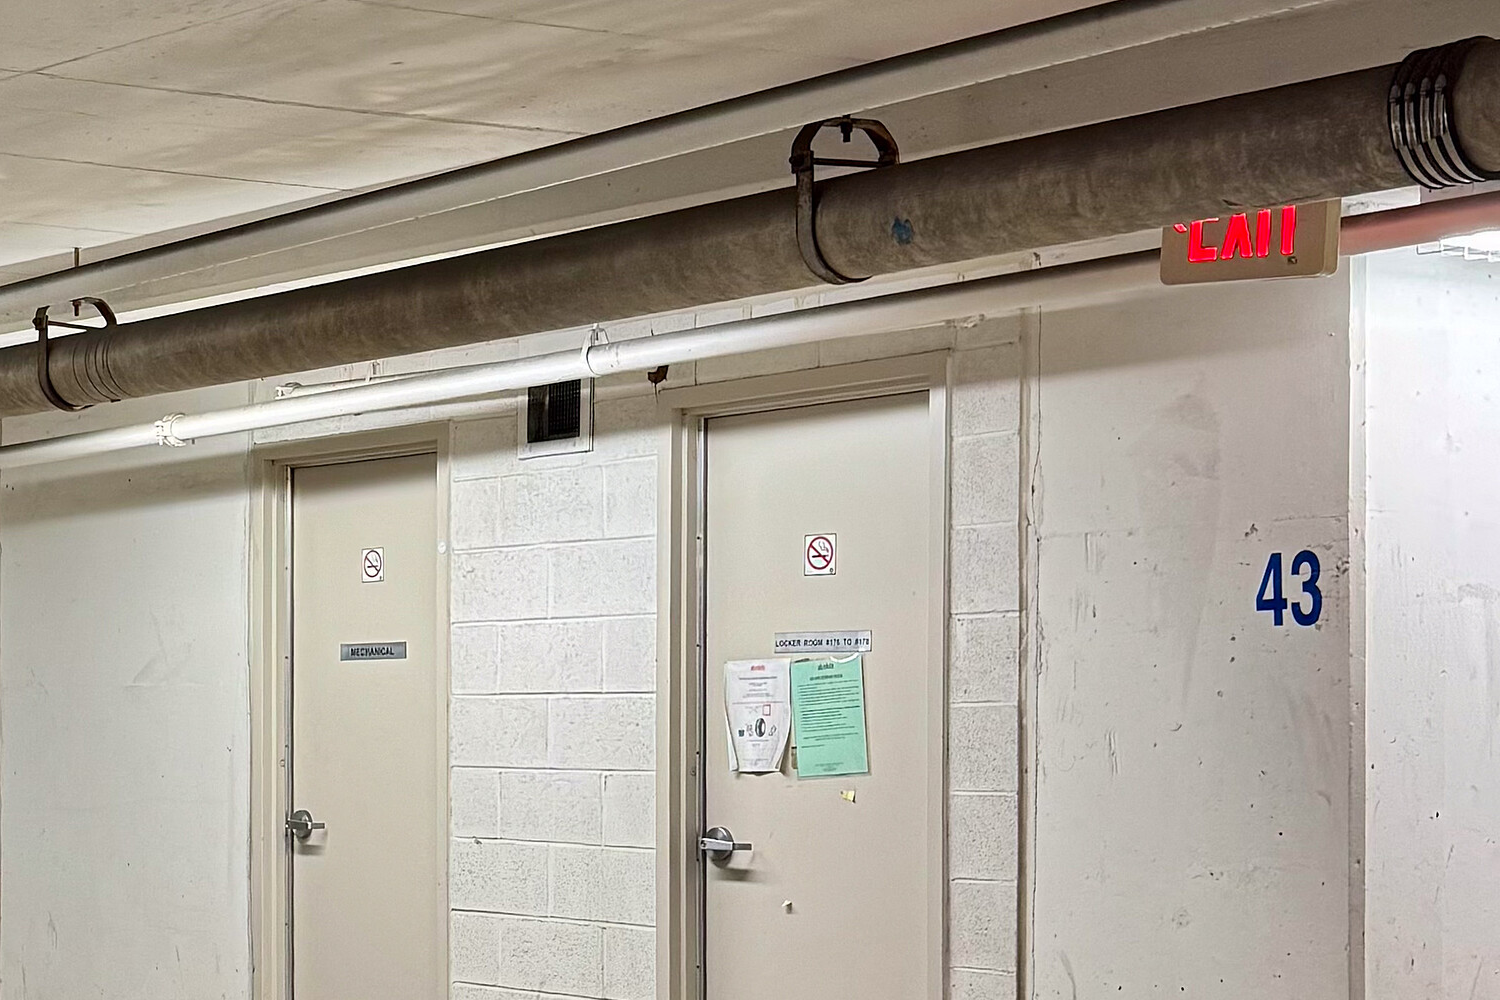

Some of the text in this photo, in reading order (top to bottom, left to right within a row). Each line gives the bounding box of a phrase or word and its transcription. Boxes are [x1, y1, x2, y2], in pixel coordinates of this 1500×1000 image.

[1256, 549, 1323, 627] 43
[775, 639, 801, 648] LOCKER
[803, 639, 823, 647] ROOM
[843, 638, 852, 646] TO
